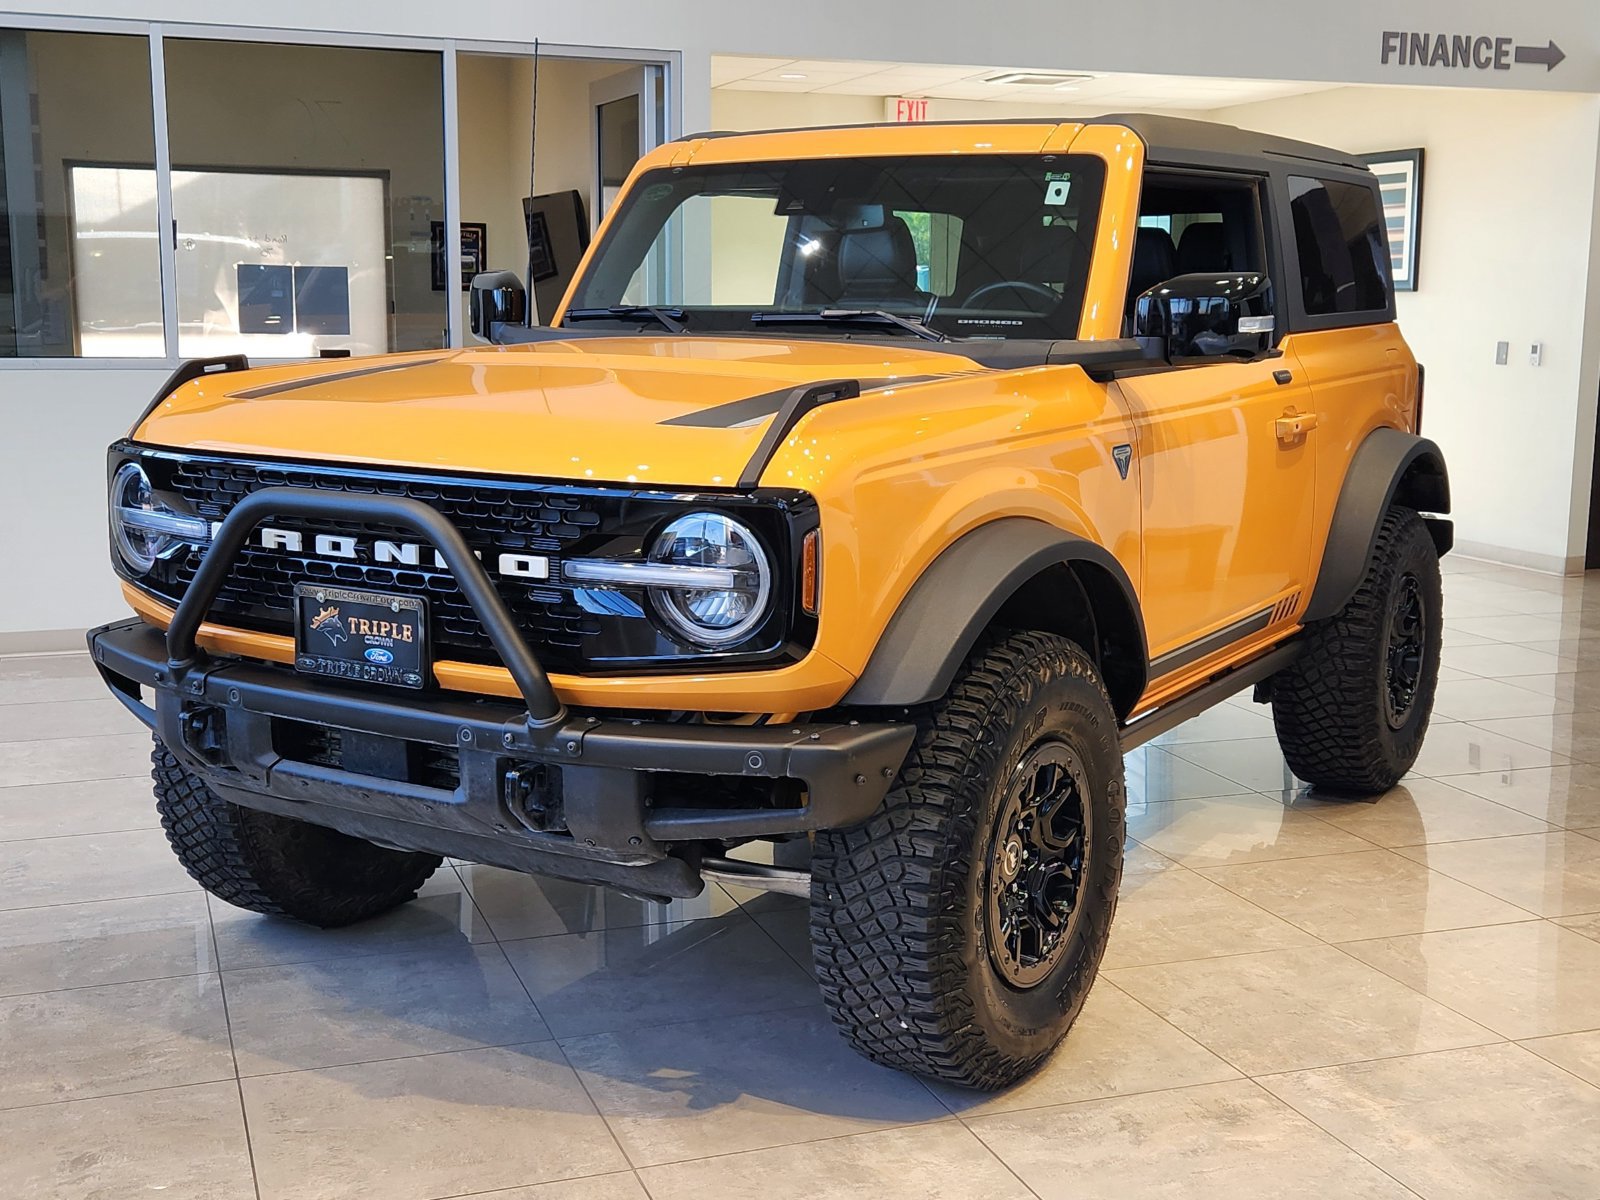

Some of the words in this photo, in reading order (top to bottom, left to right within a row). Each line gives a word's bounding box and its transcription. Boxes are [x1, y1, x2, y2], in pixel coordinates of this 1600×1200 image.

[1380, 31, 1512, 71] FINANCE
[897, 99, 928, 122] EXIT
[211, 521, 549, 580] RONO
[347, 616, 413, 643] TRIPLE
[364, 635, 394, 648] CROWN
[369, 651, 389, 662] Ford
[316, 658, 361, 679] TRIPLE
[363, 665, 404, 684] CROWN
